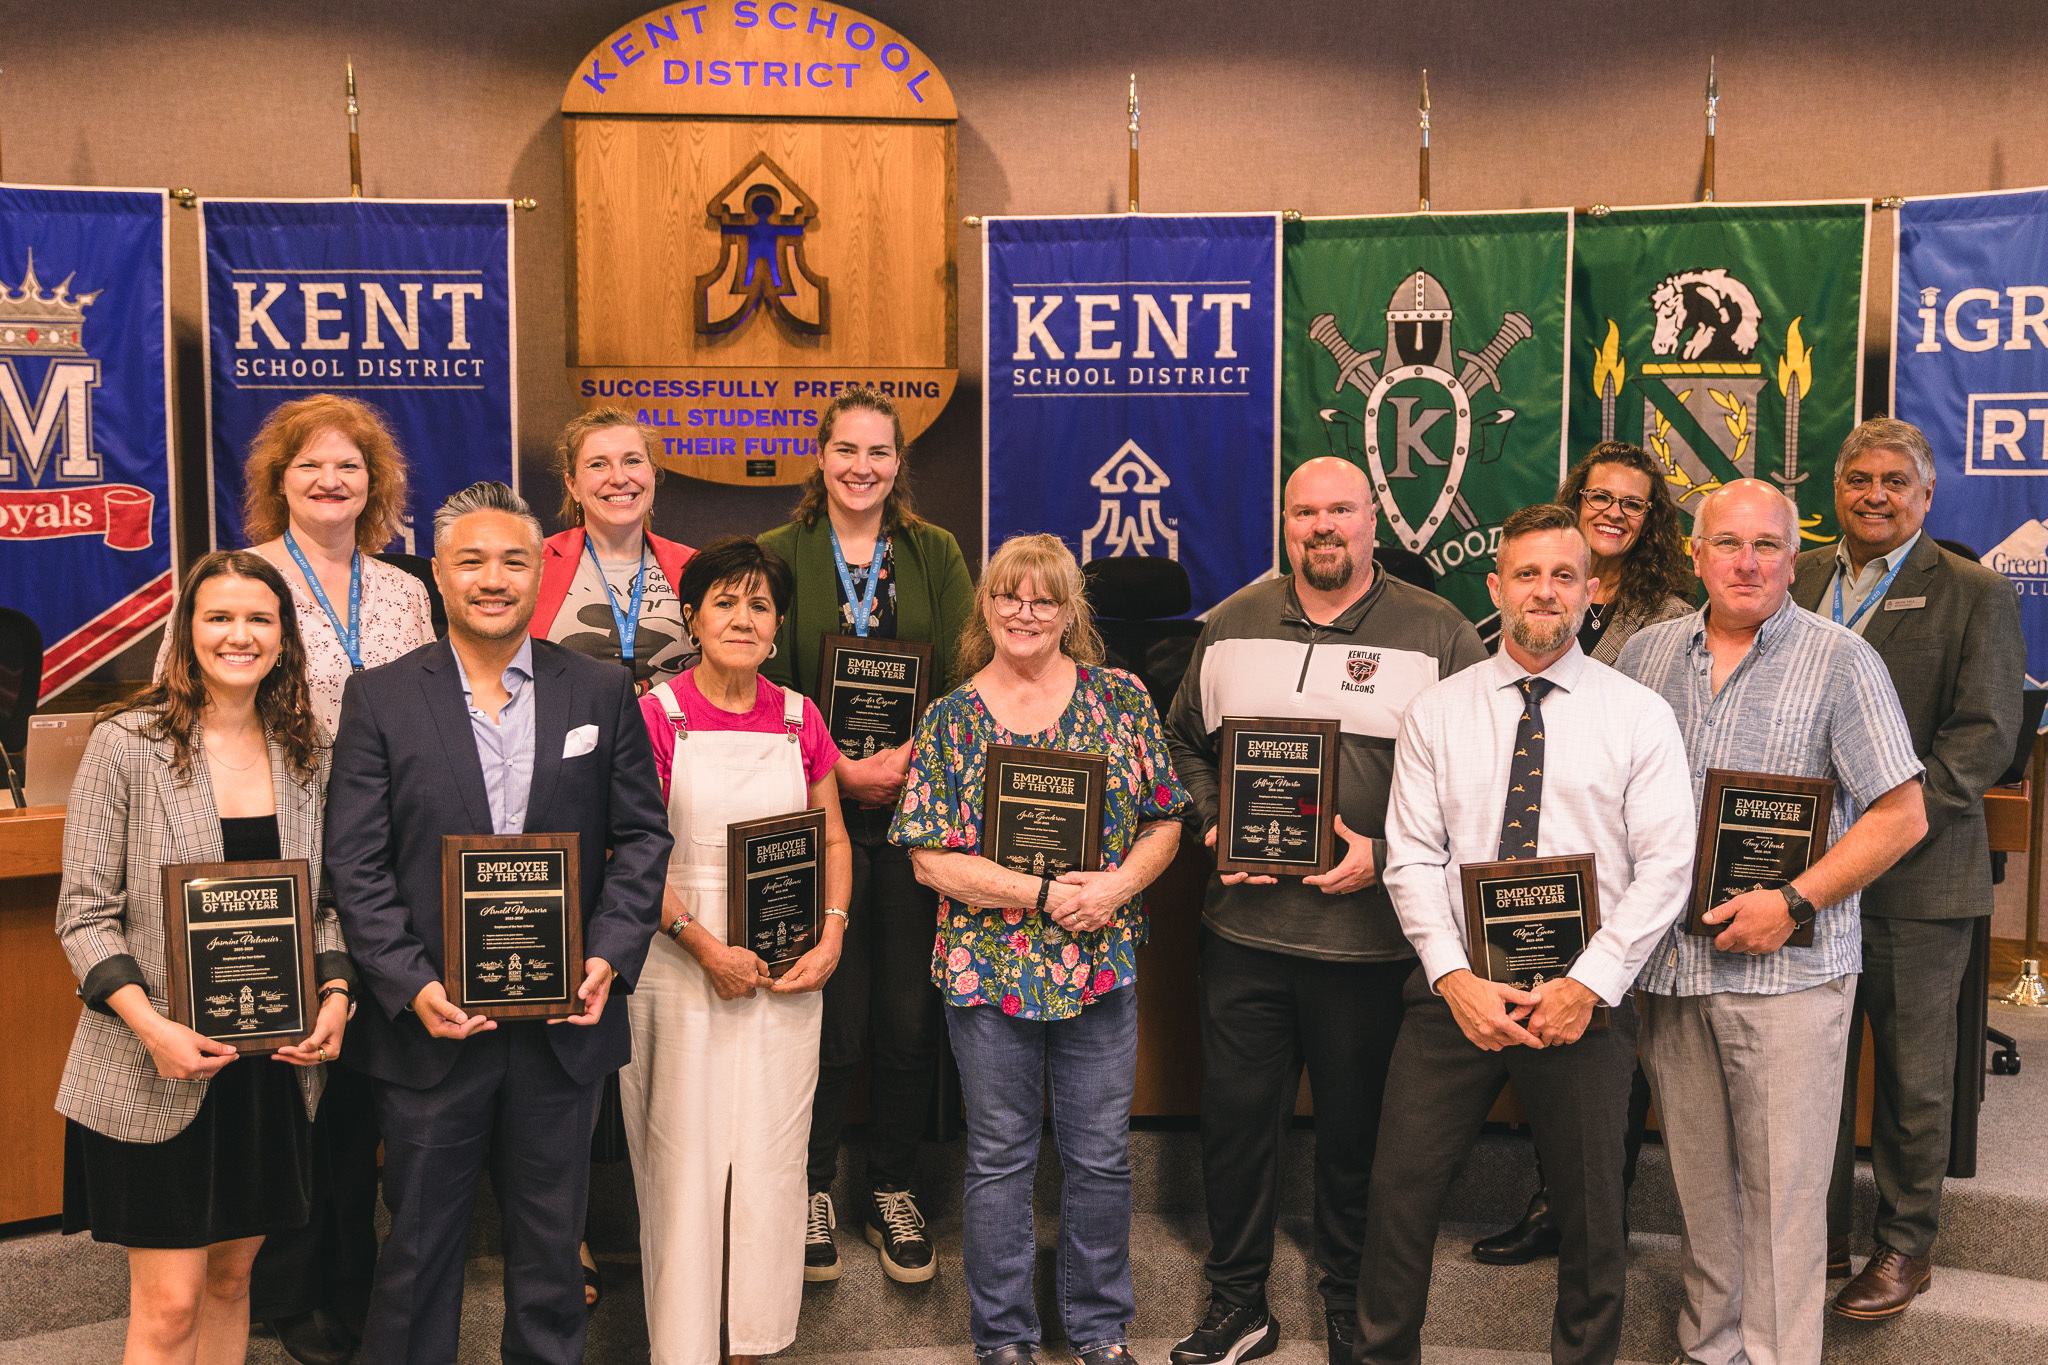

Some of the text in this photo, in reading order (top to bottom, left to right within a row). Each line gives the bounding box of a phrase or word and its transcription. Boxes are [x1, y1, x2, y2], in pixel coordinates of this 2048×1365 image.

[582, 1, 925, 103] KENT SCHOOL
[663, 60, 861, 88] DISTRICT
[233, 282, 483, 350] KENT
[1012, 293, 1251, 360] KENT
[236, 358, 485, 378] SCHOOL DISTRICT
[1013, 366, 1250, 386] SCHOOL DISTRICT
[581, 380, 778, 398] SUCCESSFULLY
[637, 409, 818, 427] ALL STUDENTS
[1386, 397, 1452, 478] K
[662, 438, 818, 456] THEIR FUTU
[649, 571, 665, 581] OH
[1348, 650, 1381, 663] KENTLAKE
[848, 658, 906, 673] EMPLOYEE
[847, 667, 905, 680] OF THE YEAR
[1341, 681, 1375, 694] FALCONS
[1248, 740, 1309, 752] EMPLOYEE
[1247, 749, 1308, 760] OF THE YEAR
[1013, 772, 1075, 787] EMPLOYEE
[1012, 781, 1074, 795] OF THE YEAR
[1735, 798, 1801, 813] EMPLOYEE
[1734, 808, 1800, 822] OF THE YEAR
[757, 838, 806, 856] EMPLOYEE
[757, 848, 806, 864] OF THE YEAR
[478, 862, 549, 873] EMPLOYEE
[477, 872, 549, 882] OF THE YEAR
[202, 889, 279, 903] EMPLOYEE
[1496, 884, 1565, 900] EMPLOYEE
[202, 899, 278, 913] OF THE YEAR
[1496, 894, 1566, 908] OF THE YEAR
[207, 936, 239, 950] Jasmine
